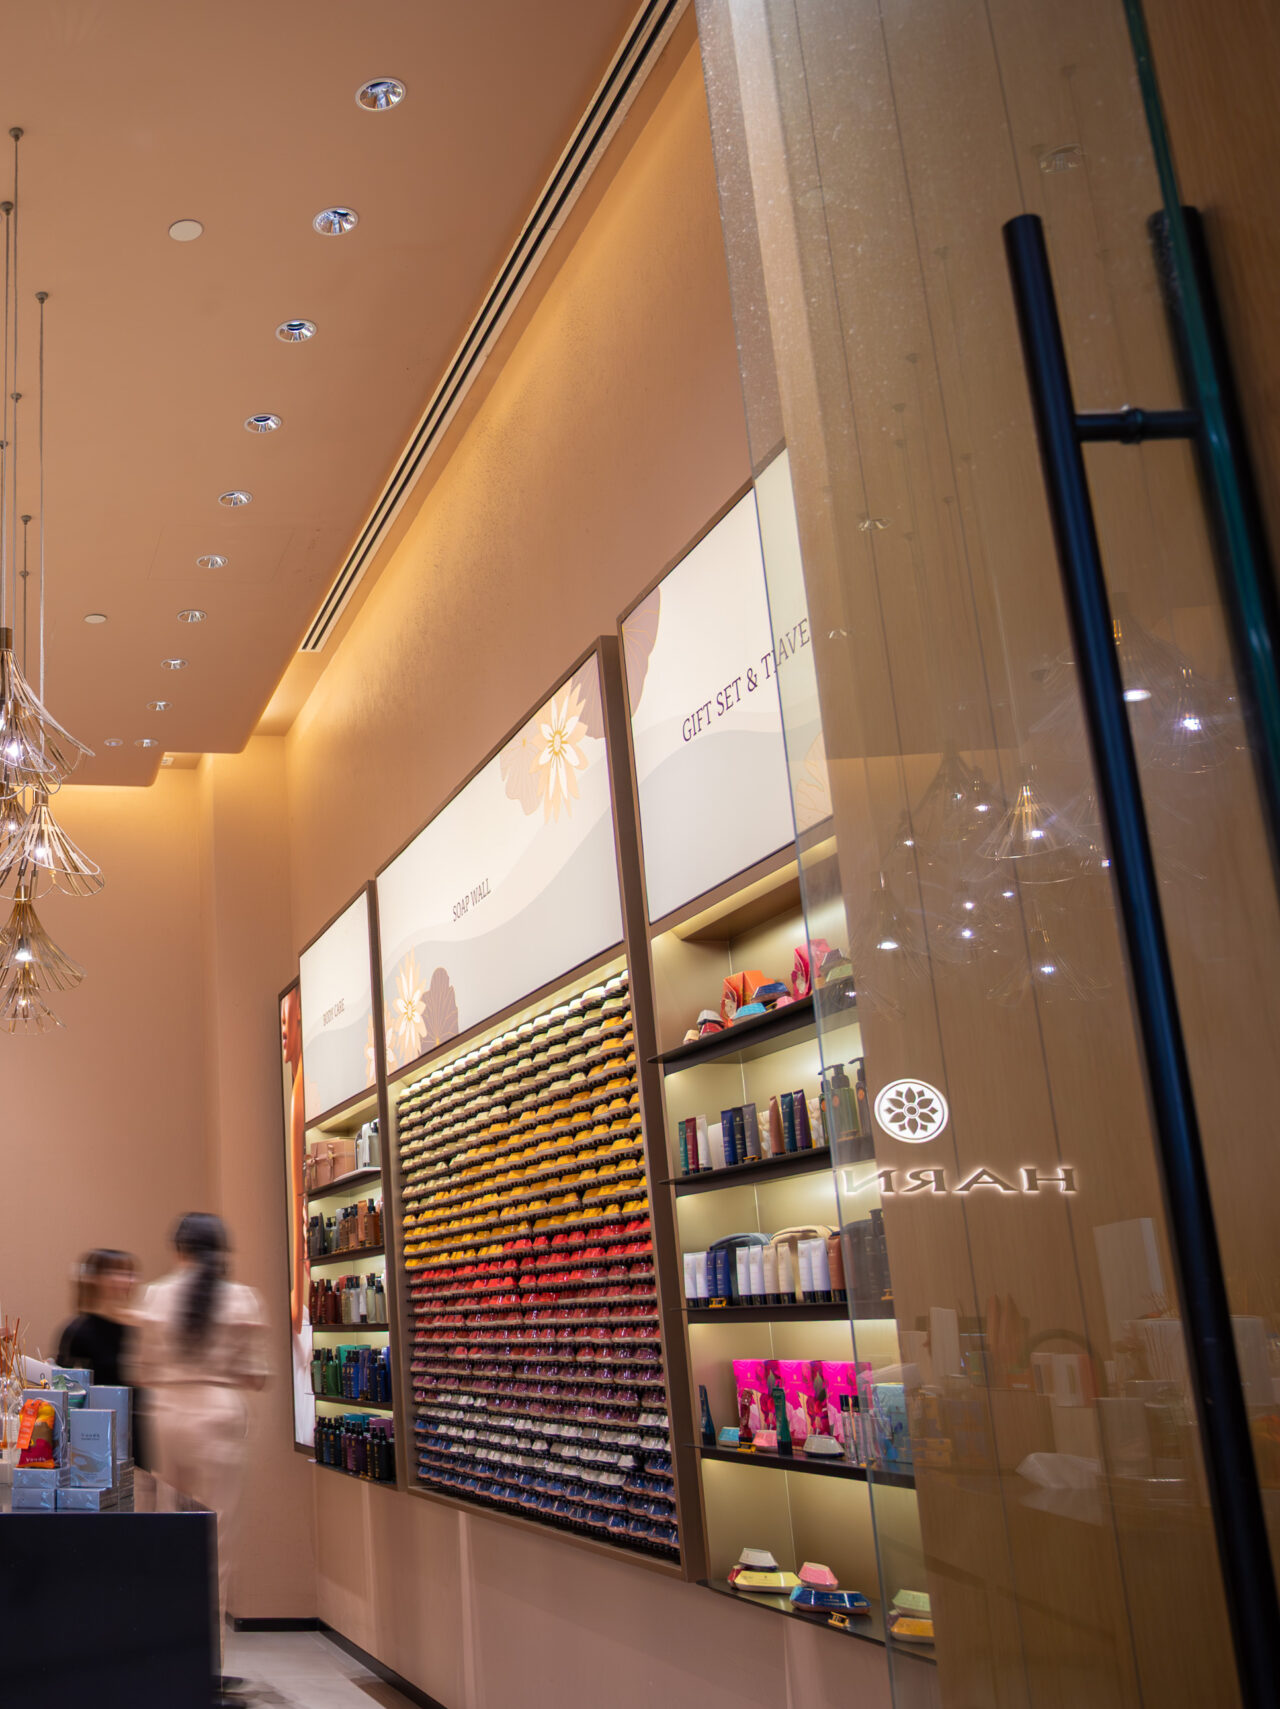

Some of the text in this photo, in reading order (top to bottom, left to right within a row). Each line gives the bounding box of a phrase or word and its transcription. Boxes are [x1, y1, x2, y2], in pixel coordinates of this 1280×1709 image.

[682, 617, 810, 742] GIFT SET & TAVE
[452, 877, 491, 922] SOAP WALL
